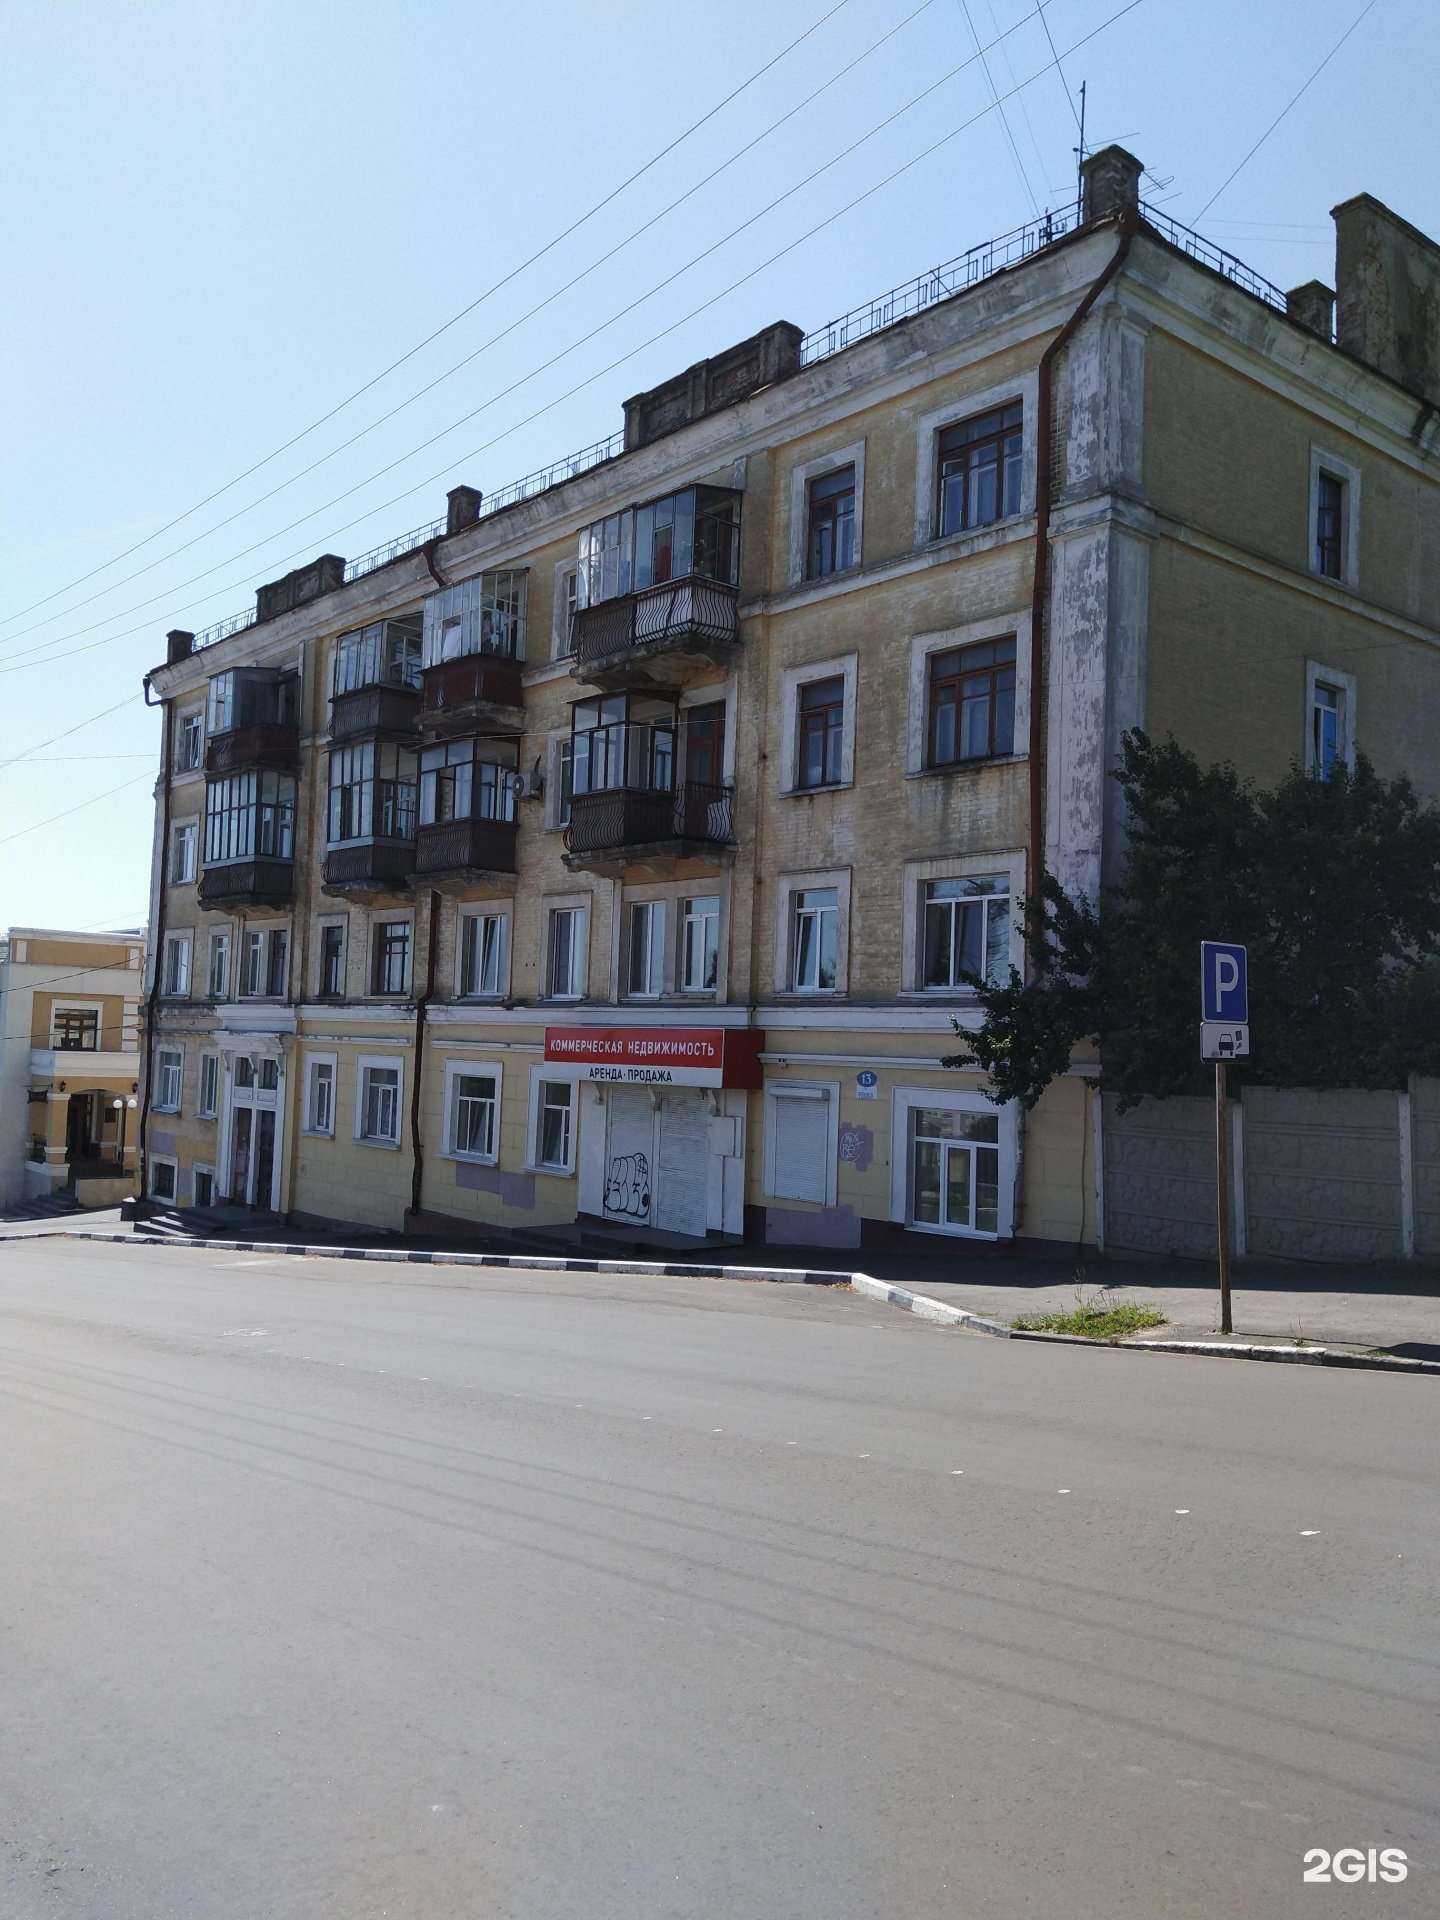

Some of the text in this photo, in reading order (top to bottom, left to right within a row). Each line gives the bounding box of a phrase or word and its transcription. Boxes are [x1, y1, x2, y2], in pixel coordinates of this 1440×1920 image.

[1215, 952, 1239, 1013] P
[550, 1039, 715, 1056] КОММЕРЧЕСКАЯ НЕДВИЖИМОСТЬ
